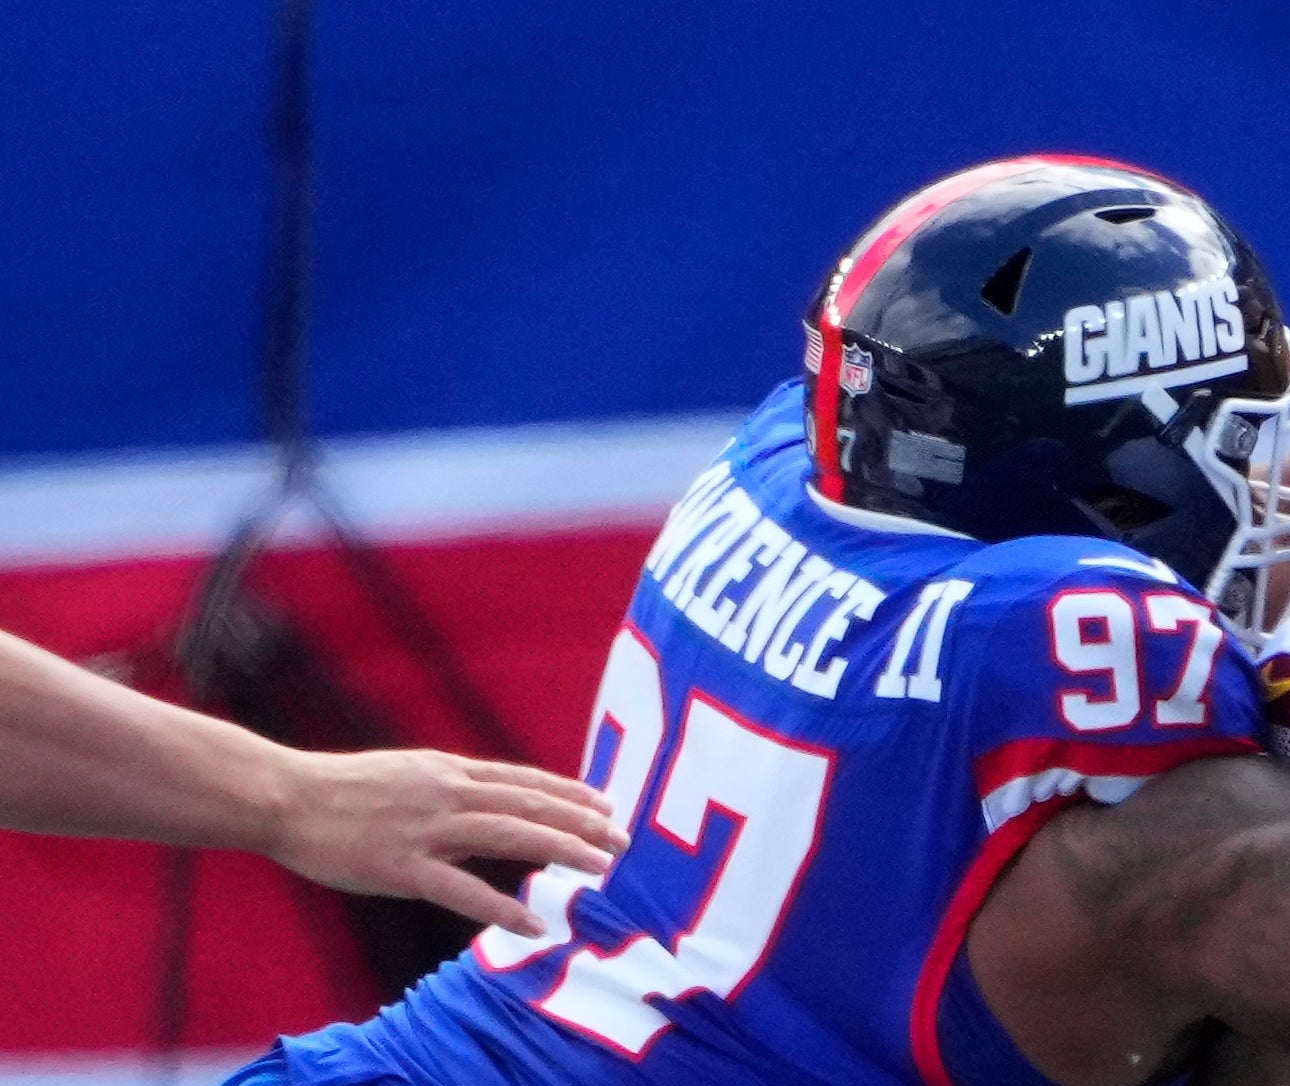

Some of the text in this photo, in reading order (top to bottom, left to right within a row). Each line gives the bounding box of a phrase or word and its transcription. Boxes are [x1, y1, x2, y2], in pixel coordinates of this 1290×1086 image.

[1064, 274, 1246, 384] GIANTS
[647, 437, 976, 703] WRENCE II
[1048, 588, 1225, 734] 97
[474, 622, 837, 1063] 97
